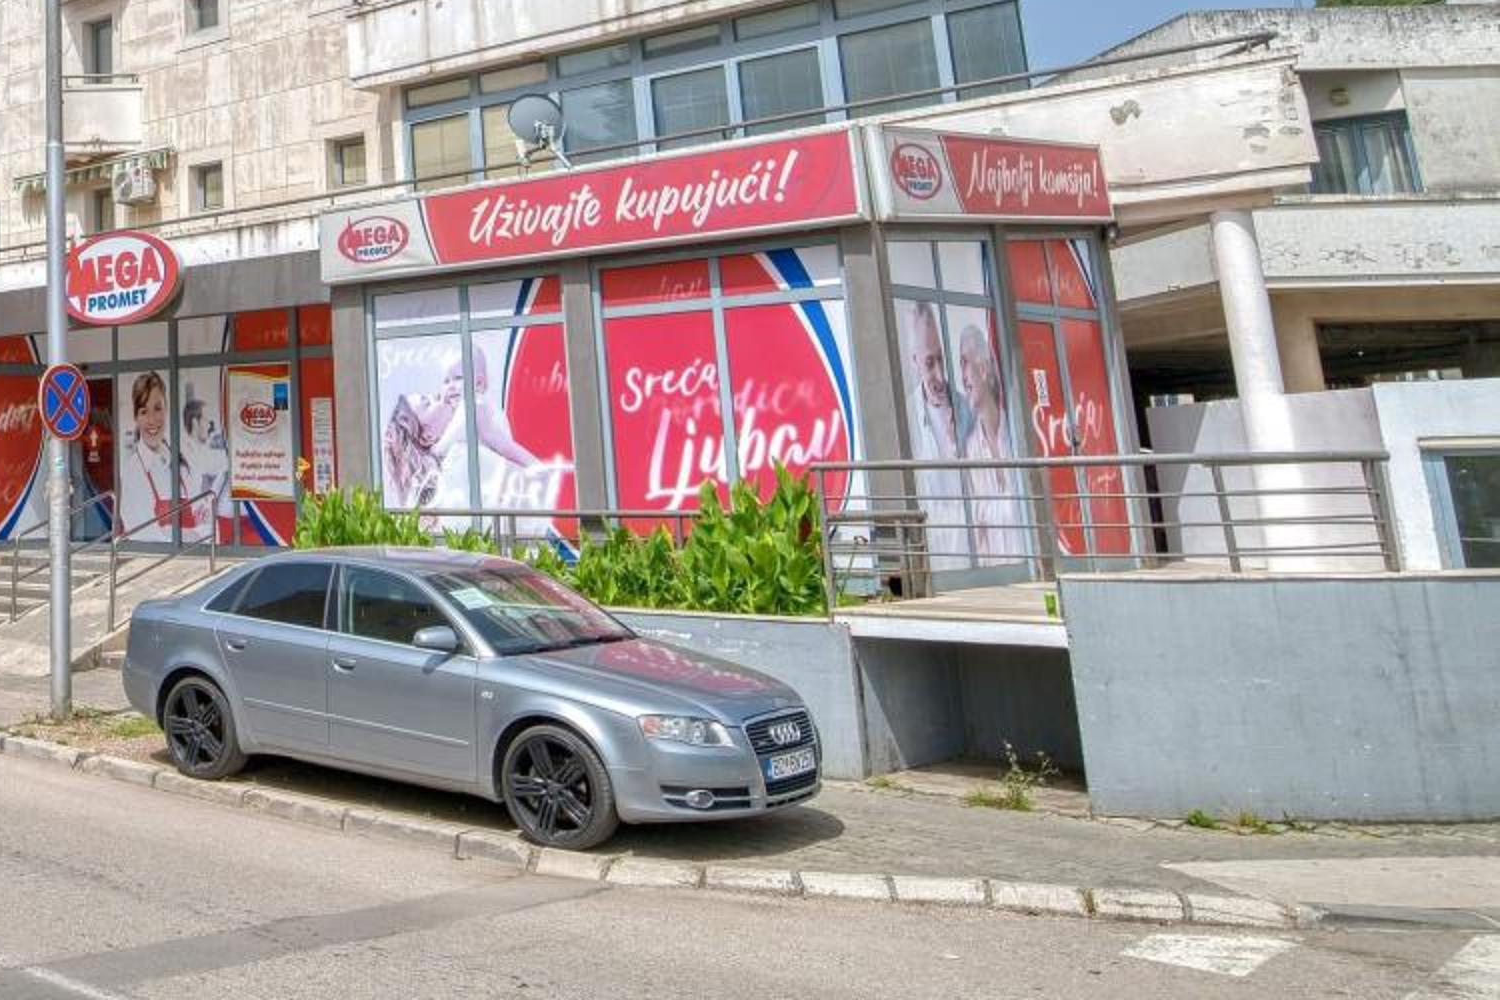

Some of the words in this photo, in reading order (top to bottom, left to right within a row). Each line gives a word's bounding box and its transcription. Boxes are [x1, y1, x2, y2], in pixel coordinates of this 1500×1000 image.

[468, 183, 602, 247] Uživajte
[615, 148, 799, 231] kupujući!
[966, 148, 1035, 209] Najbolji
[1038, 156, 1099, 209] komšija!
[347, 224, 400, 248] MEGA
[67, 246, 162, 298] MEGA
[88, 288, 148, 313] PROMET
[620, 357, 719, 413] Sreća
[644, 406, 840, 512] Ljubav
